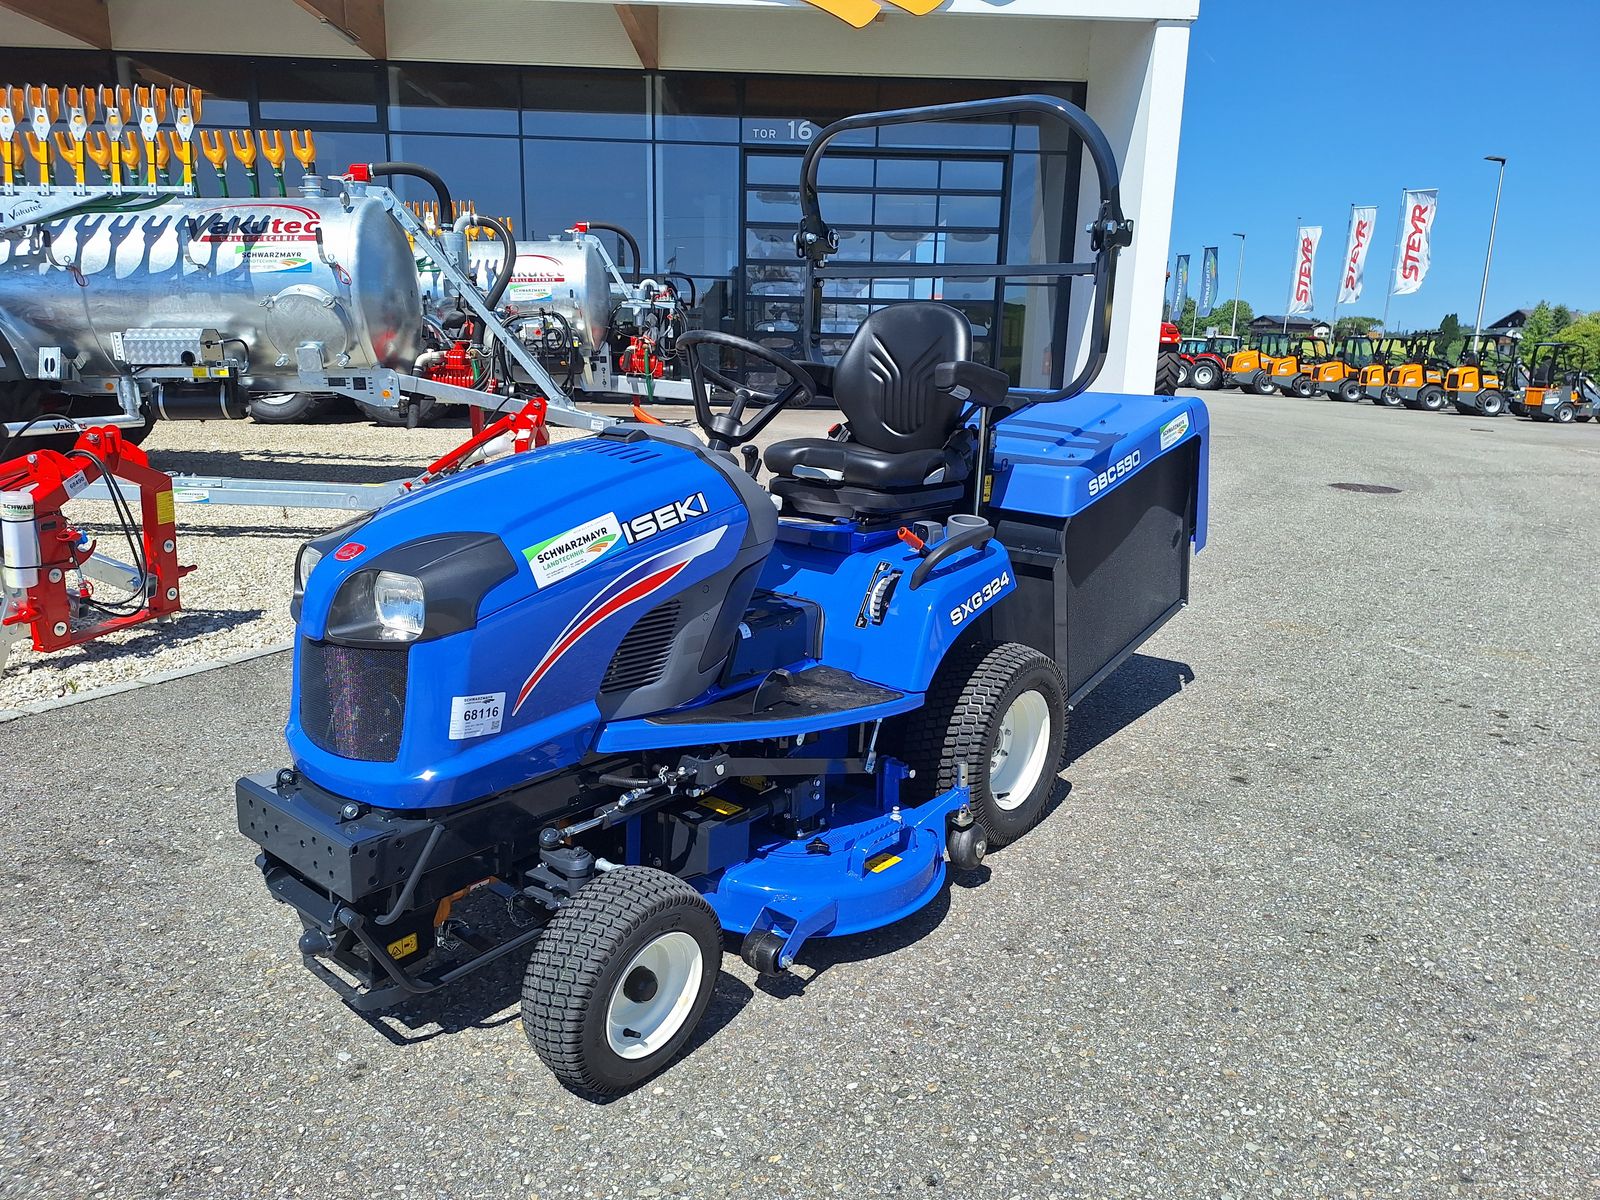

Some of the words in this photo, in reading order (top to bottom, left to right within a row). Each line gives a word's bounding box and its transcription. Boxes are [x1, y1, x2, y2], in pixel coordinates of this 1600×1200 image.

[752, 128, 777, 139] TOR
[787, 120, 812, 140] 16
[8, 204, 43, 220] Vakutec
[187, 213, 320, 241] Vakutec
[1345, 220, 1368, 291] STEYR
[1401, 204, 1428, 281] STEYR
[1296, 236, 1313, 303] STEYR
[1088, 449, 1141, 497] SBC590
[621, 491, 709, 545] ISEKI
[537, 527, 608, 563] SCHWARZMAYR
[542, 548, 585, 571] LANDTECHNIK
[950, 571, 1010, 626] SXG324
[464, 706, 499, 722] 68116
